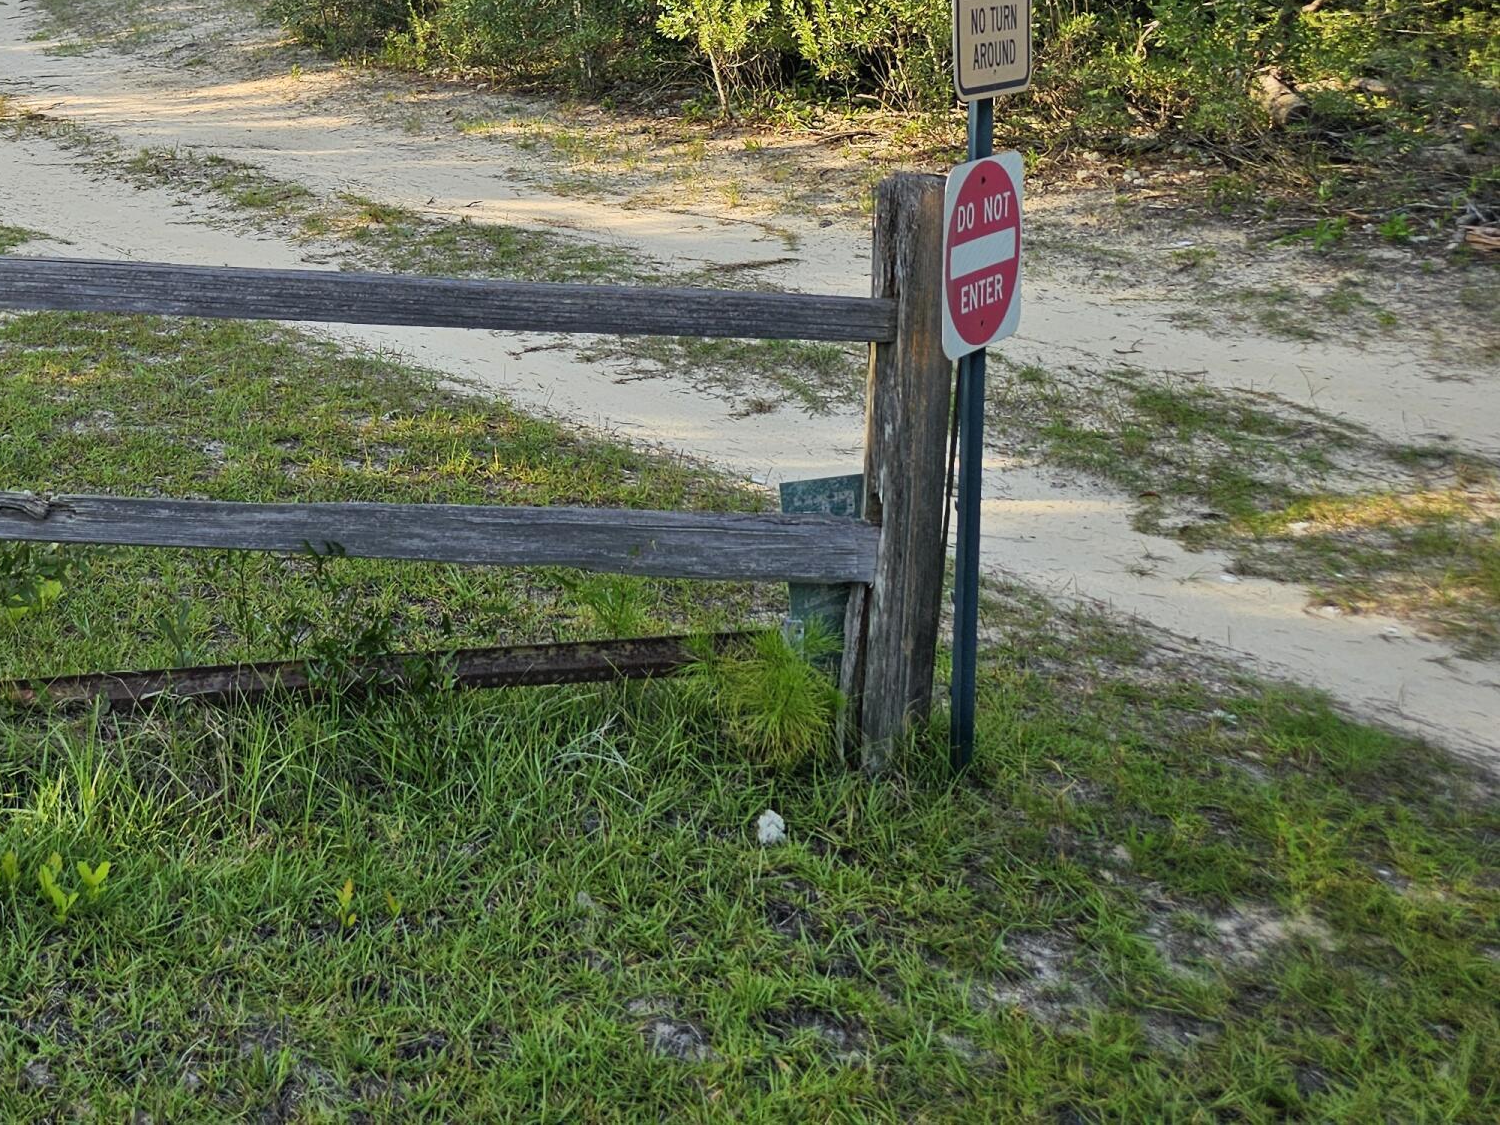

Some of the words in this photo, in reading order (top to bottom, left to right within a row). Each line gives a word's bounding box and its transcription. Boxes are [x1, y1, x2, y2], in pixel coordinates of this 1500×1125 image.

[971, 7, 985, 35] NO
[990, 4, 1017, 32] TURN
[973, 39, 1016, 71] AROUND
[957, 202, 975, 233] DO
[984, 191, 1011, 224] NOT
[961, 273, 1003, 314] ENTER
